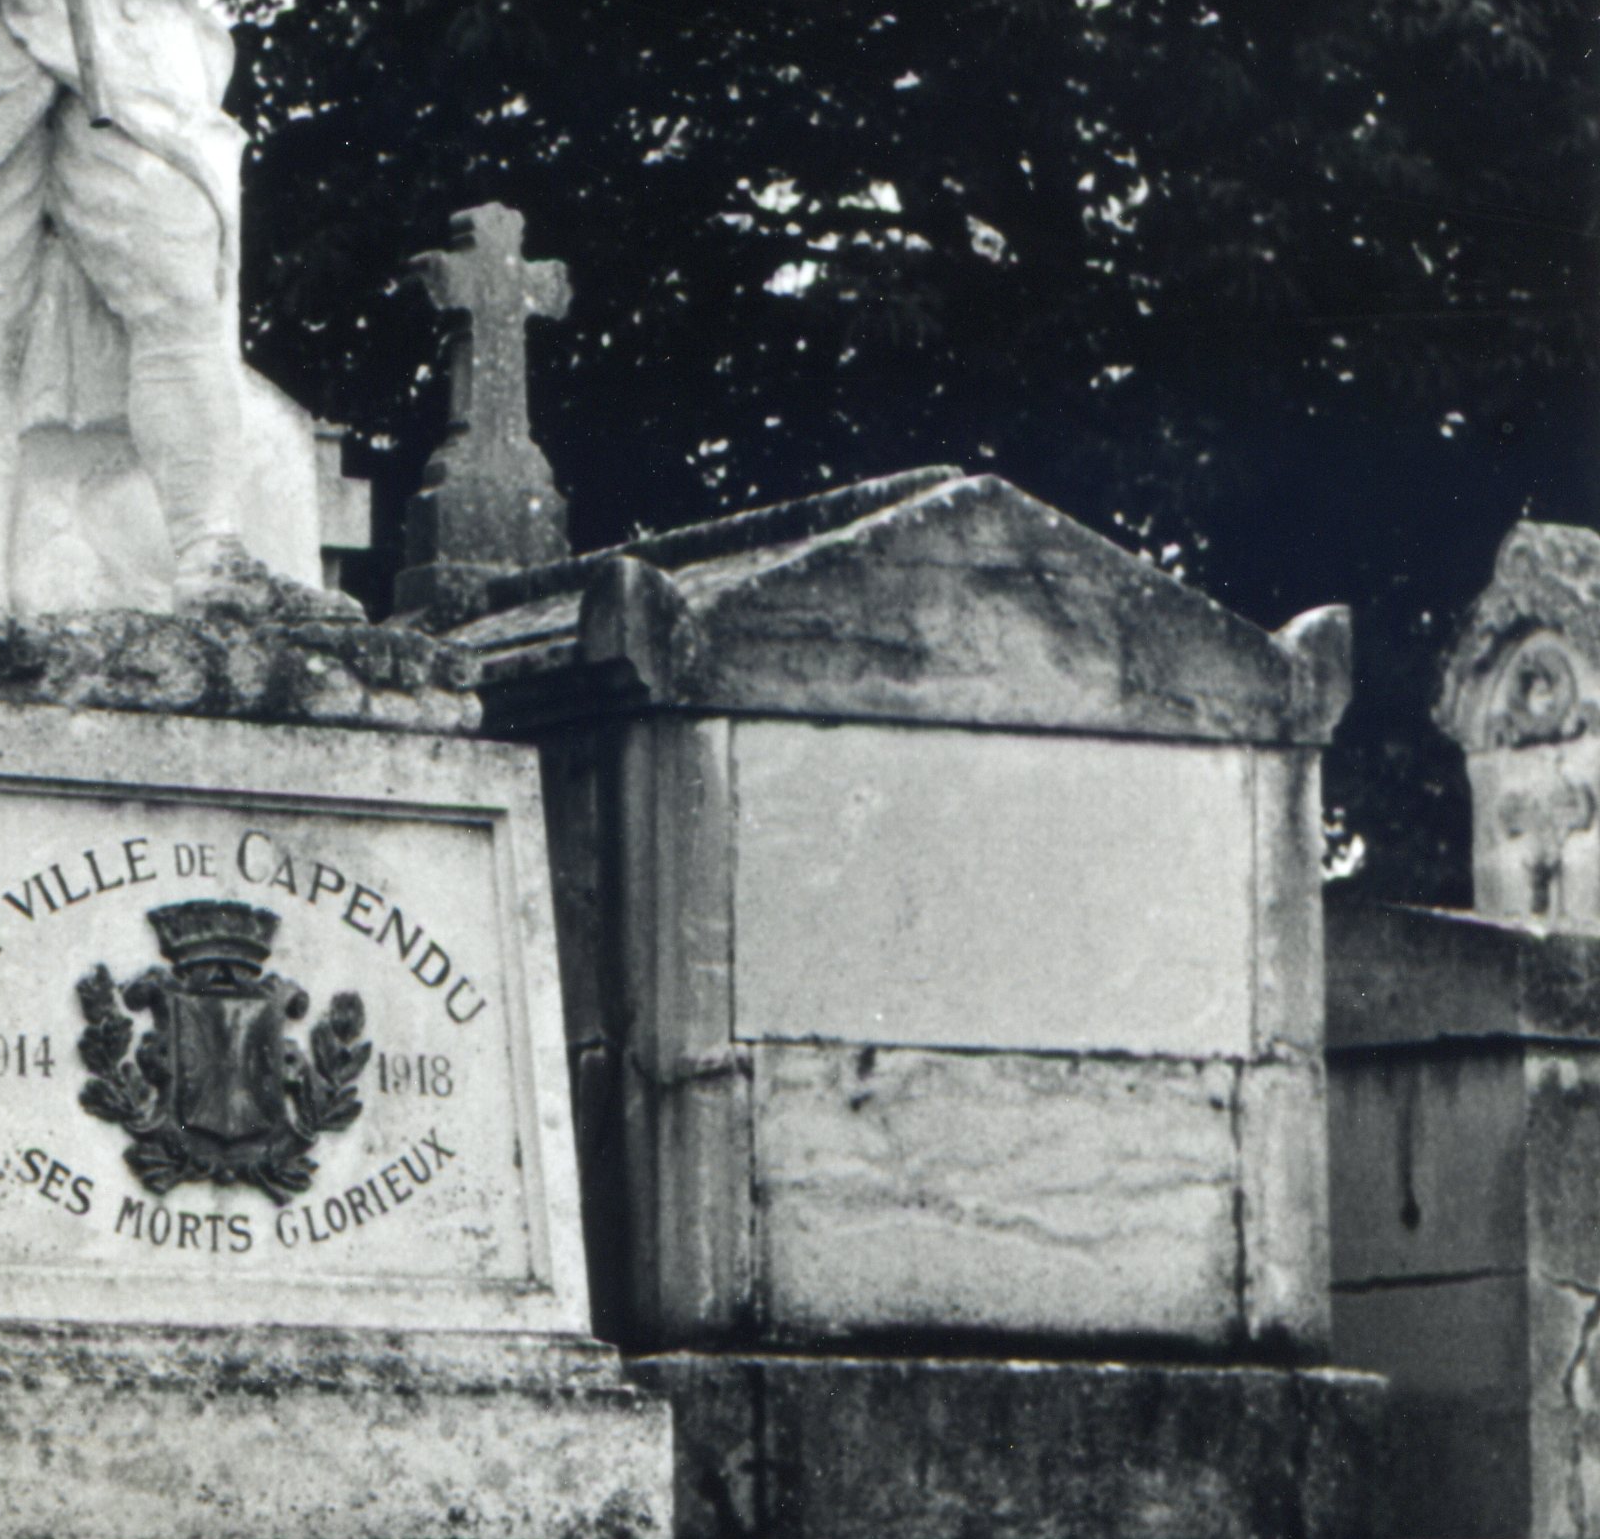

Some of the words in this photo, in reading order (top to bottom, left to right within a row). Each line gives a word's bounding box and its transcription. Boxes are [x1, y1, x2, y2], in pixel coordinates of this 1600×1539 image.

[3, 838, 157, 921] VILLE
[175, 844, 216, 877] DE
[236, 830, 487, 1024] CAPENDU
[376, 1051, 454, 1097] 1918
[16, 1147, 95, 1216] SES
[115, 1199, 253, 1253] MORTS
[276, 1128, 456, 1248] GLORIEUX
